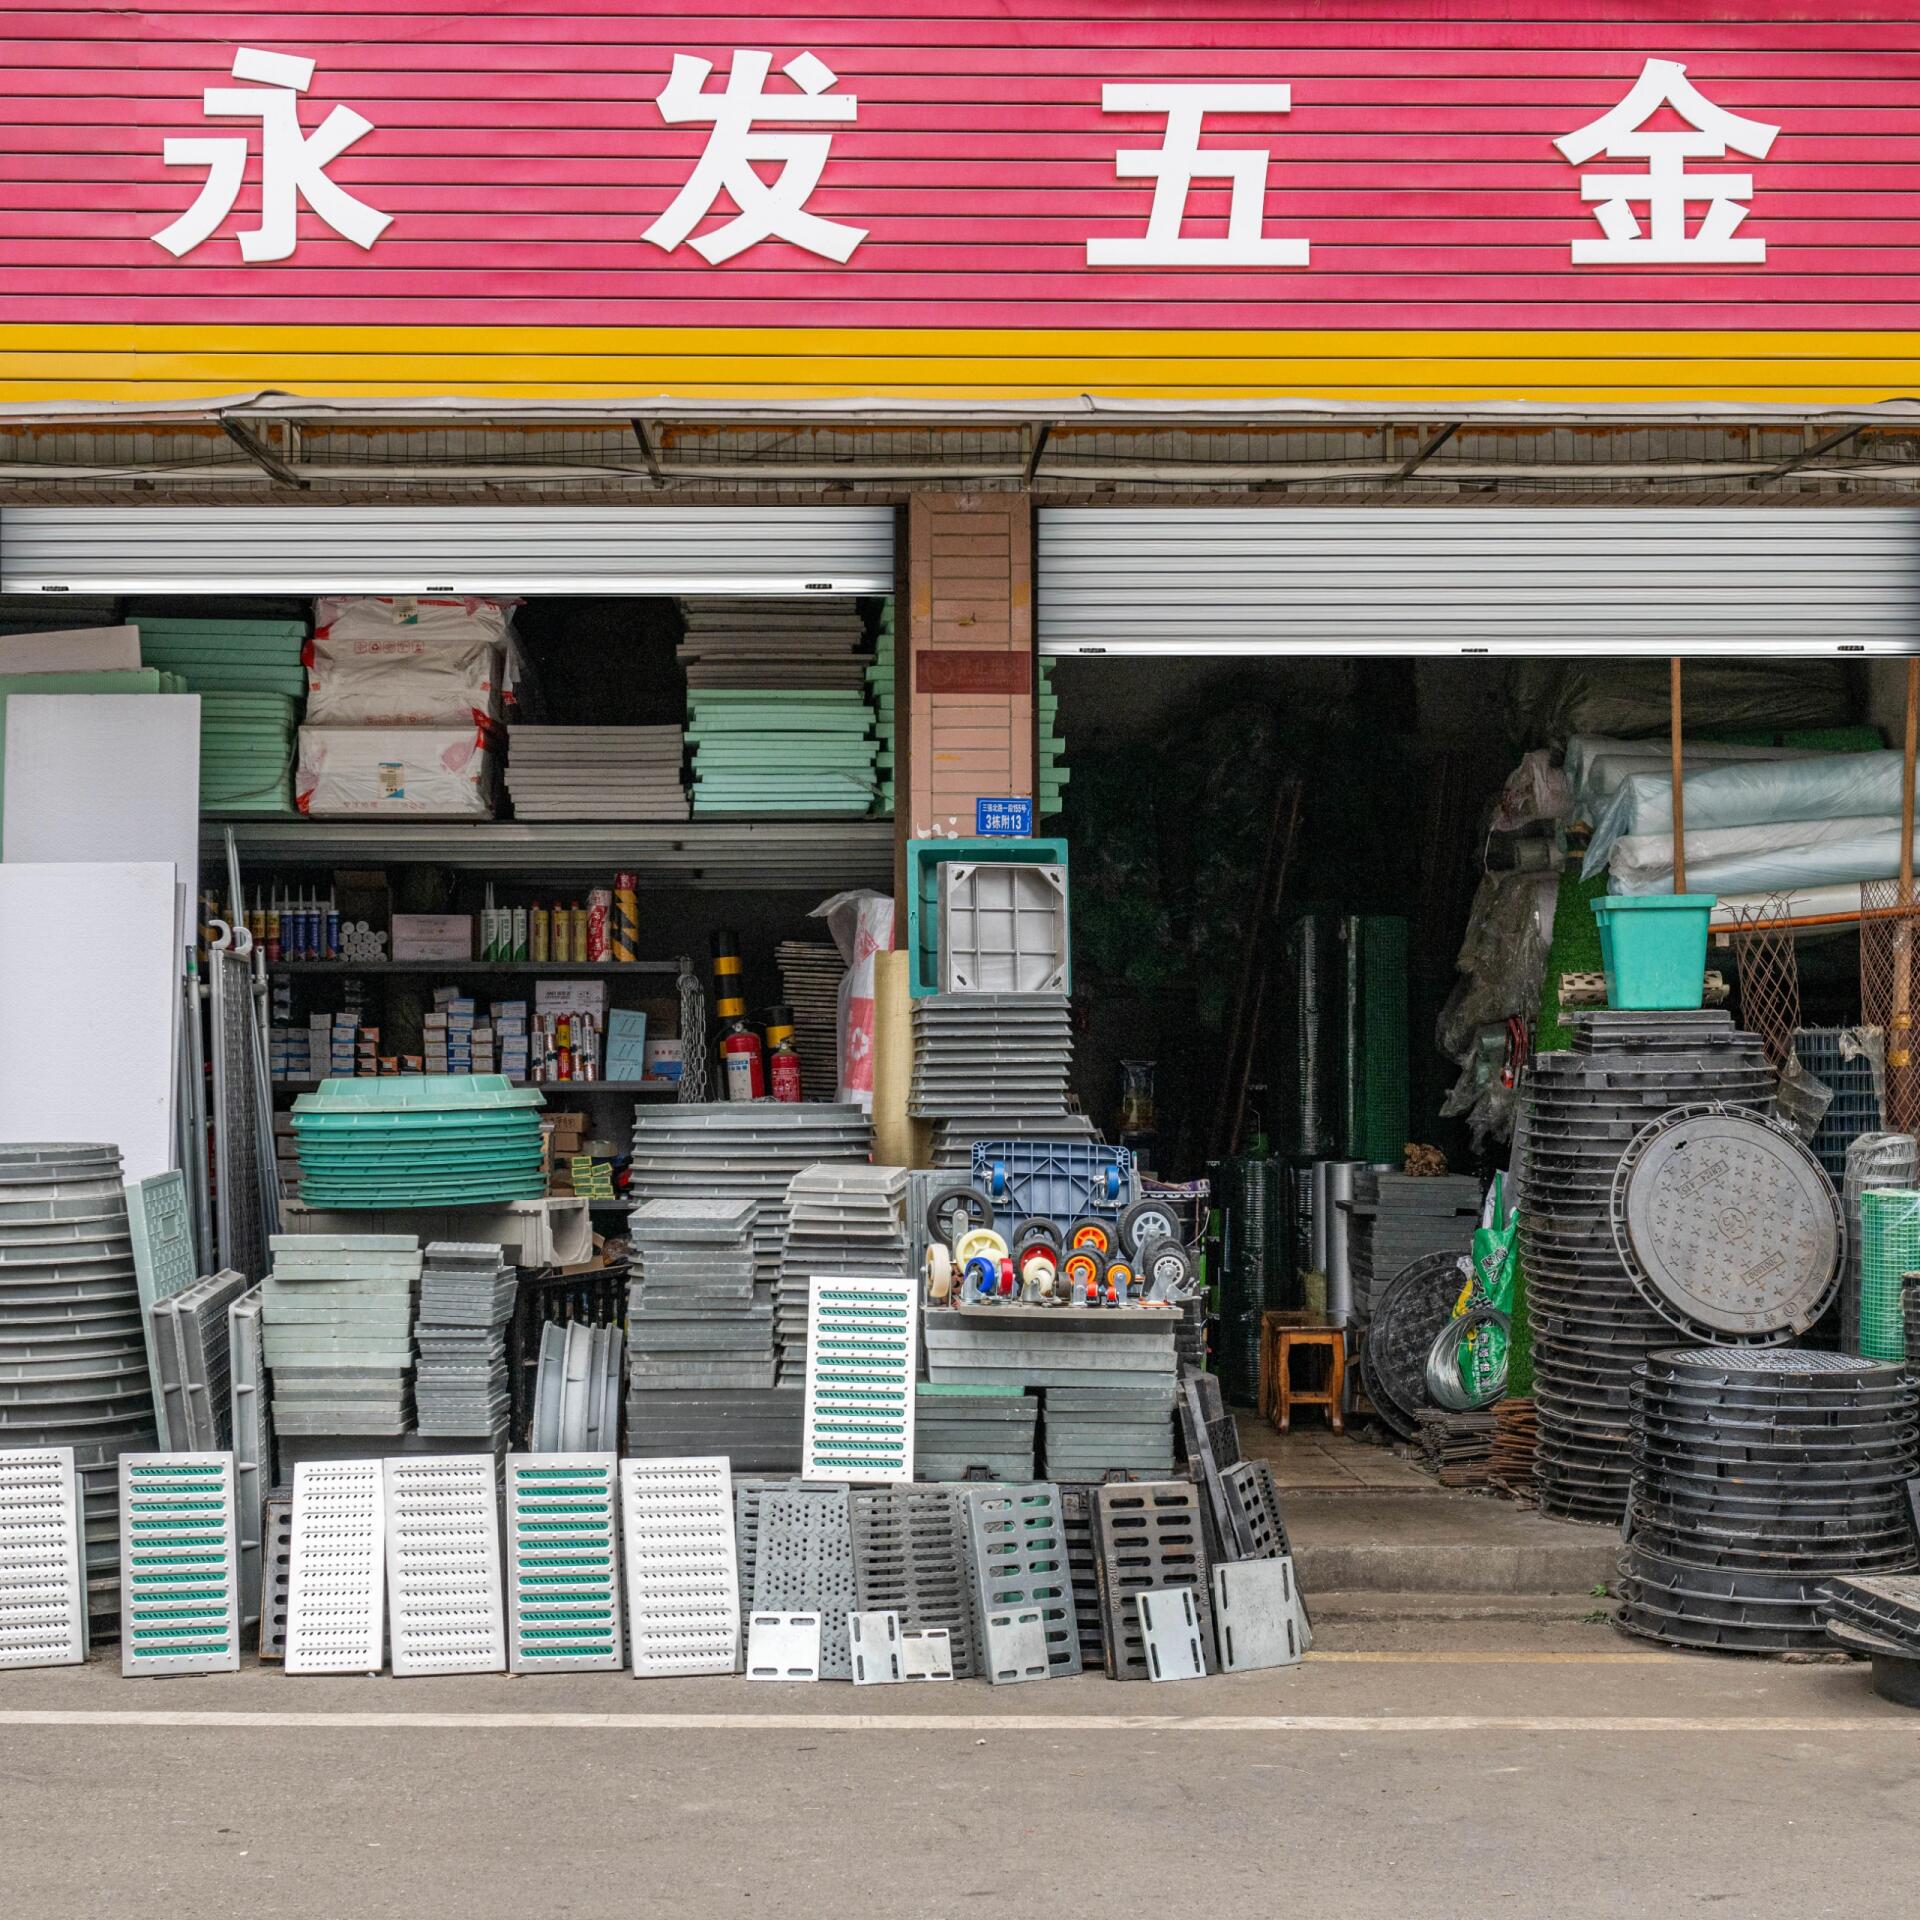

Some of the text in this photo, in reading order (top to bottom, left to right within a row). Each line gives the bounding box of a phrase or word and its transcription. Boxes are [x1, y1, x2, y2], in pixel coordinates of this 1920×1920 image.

[151, 47, 1780, 266] 永发五金
[985, 814, 1022, 830] 3栋附13
